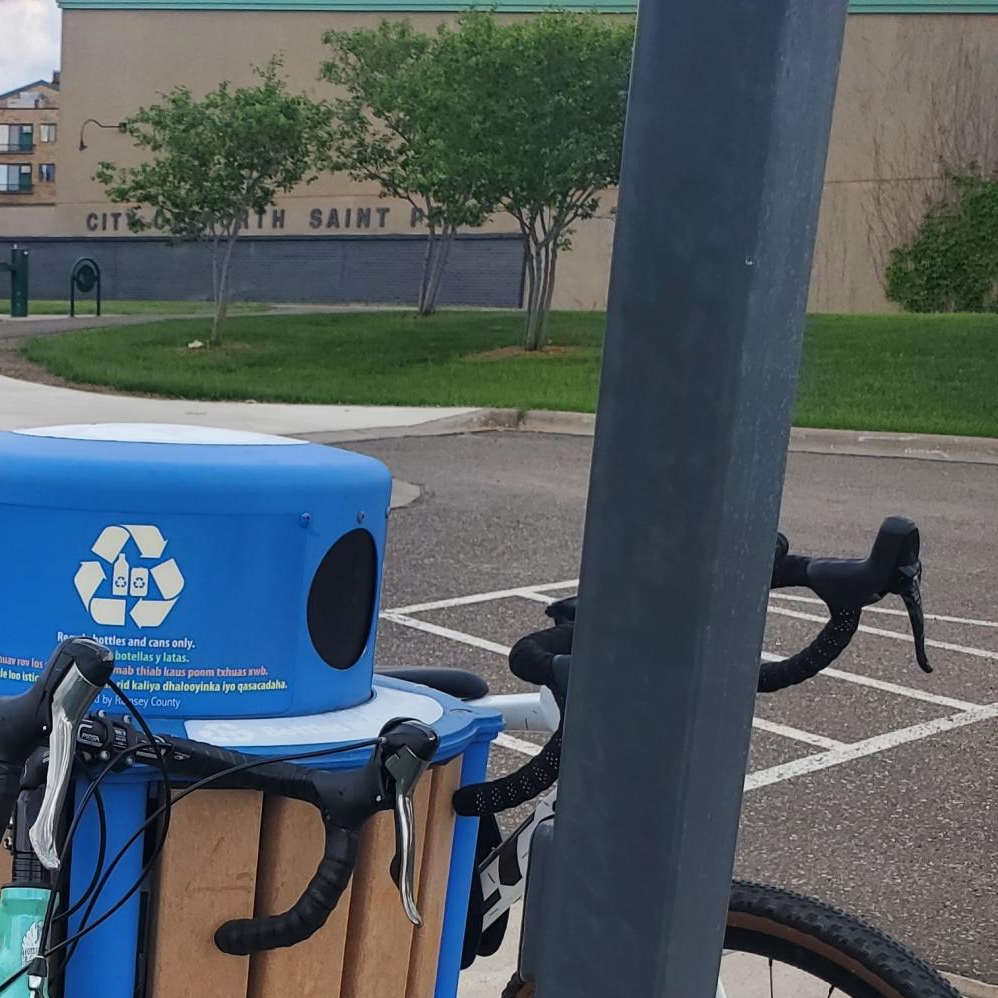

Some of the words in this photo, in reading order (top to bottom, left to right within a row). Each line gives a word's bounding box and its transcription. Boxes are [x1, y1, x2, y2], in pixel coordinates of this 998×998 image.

[309, 207, 390, 229] SAINT
[93, 634, 126, 647] bottles
[127, 636, 147, 648] and
[148, 639, 170, 648] cans
[172, 637, 196, 650] only.
[115, 650, 154, 662] botellas
[155, 654, 162, 665] y
[163, 652, 190, 663] latas.
[31, 657, 44, 669] los
[136, 665, 162, 677] thiab
[164, 666, 187, 677] kaus
[187, 668, 215, 679] poom
[216, 667, 247, 677] txhuas
[8, 669, 21, 681] loo
[131, 680, 161, 692] kaliya
[162, 681, 220, 695] dhalooyinka
[222, 680, 236, 694] iyo
[237, 679, 288, 693] qasacadaha.
[102, 694, 113, 707] by
[115, 695, 148, 709] Rsey
[150, 696, 181, 710] County
